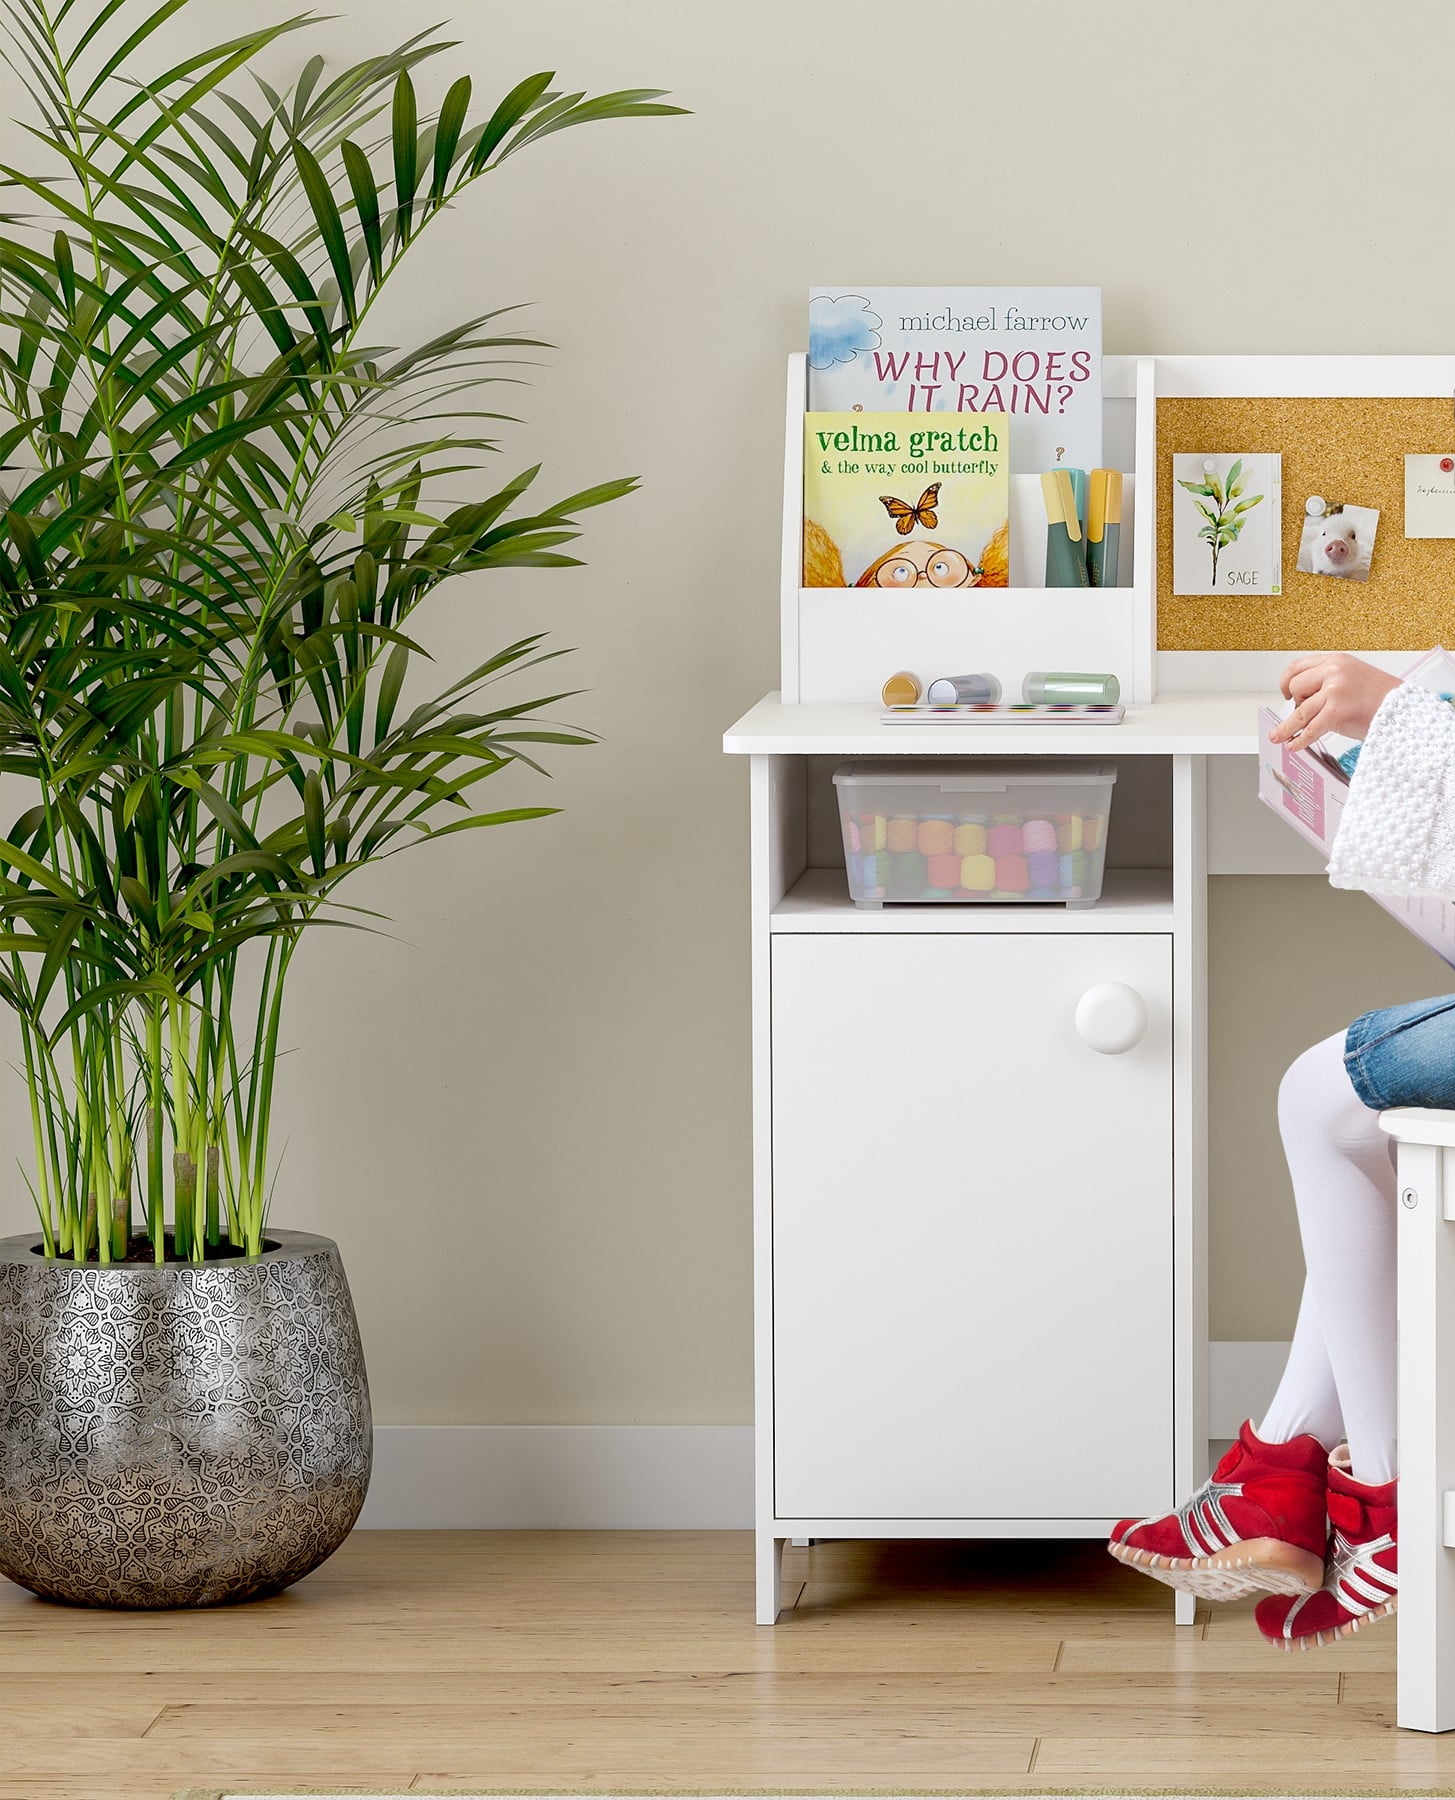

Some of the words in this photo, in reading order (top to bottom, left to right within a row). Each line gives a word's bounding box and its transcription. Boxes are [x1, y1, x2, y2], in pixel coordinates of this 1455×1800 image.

[899, 307, 997, 333] michael
[1004, 307, 1089, 331] farrow
[873, 350, 967, 382] WHY
[982, 350, 1091, 382] DOES
[907, 384, 942, 412] IT
[956, 384, 1075, 414] RAIN?
[816, 425, 901, 452] velma
[909, 425, 998, 458] gratch
[821, 460, 832, 474] &
[838, 460, 860, 474] the
[865, 463, 897, 477] way
[900, 460, 928, 474] cool
[933, 460, 998, 477] butterfly
[1227, 571, 1259, 586] SAGE
